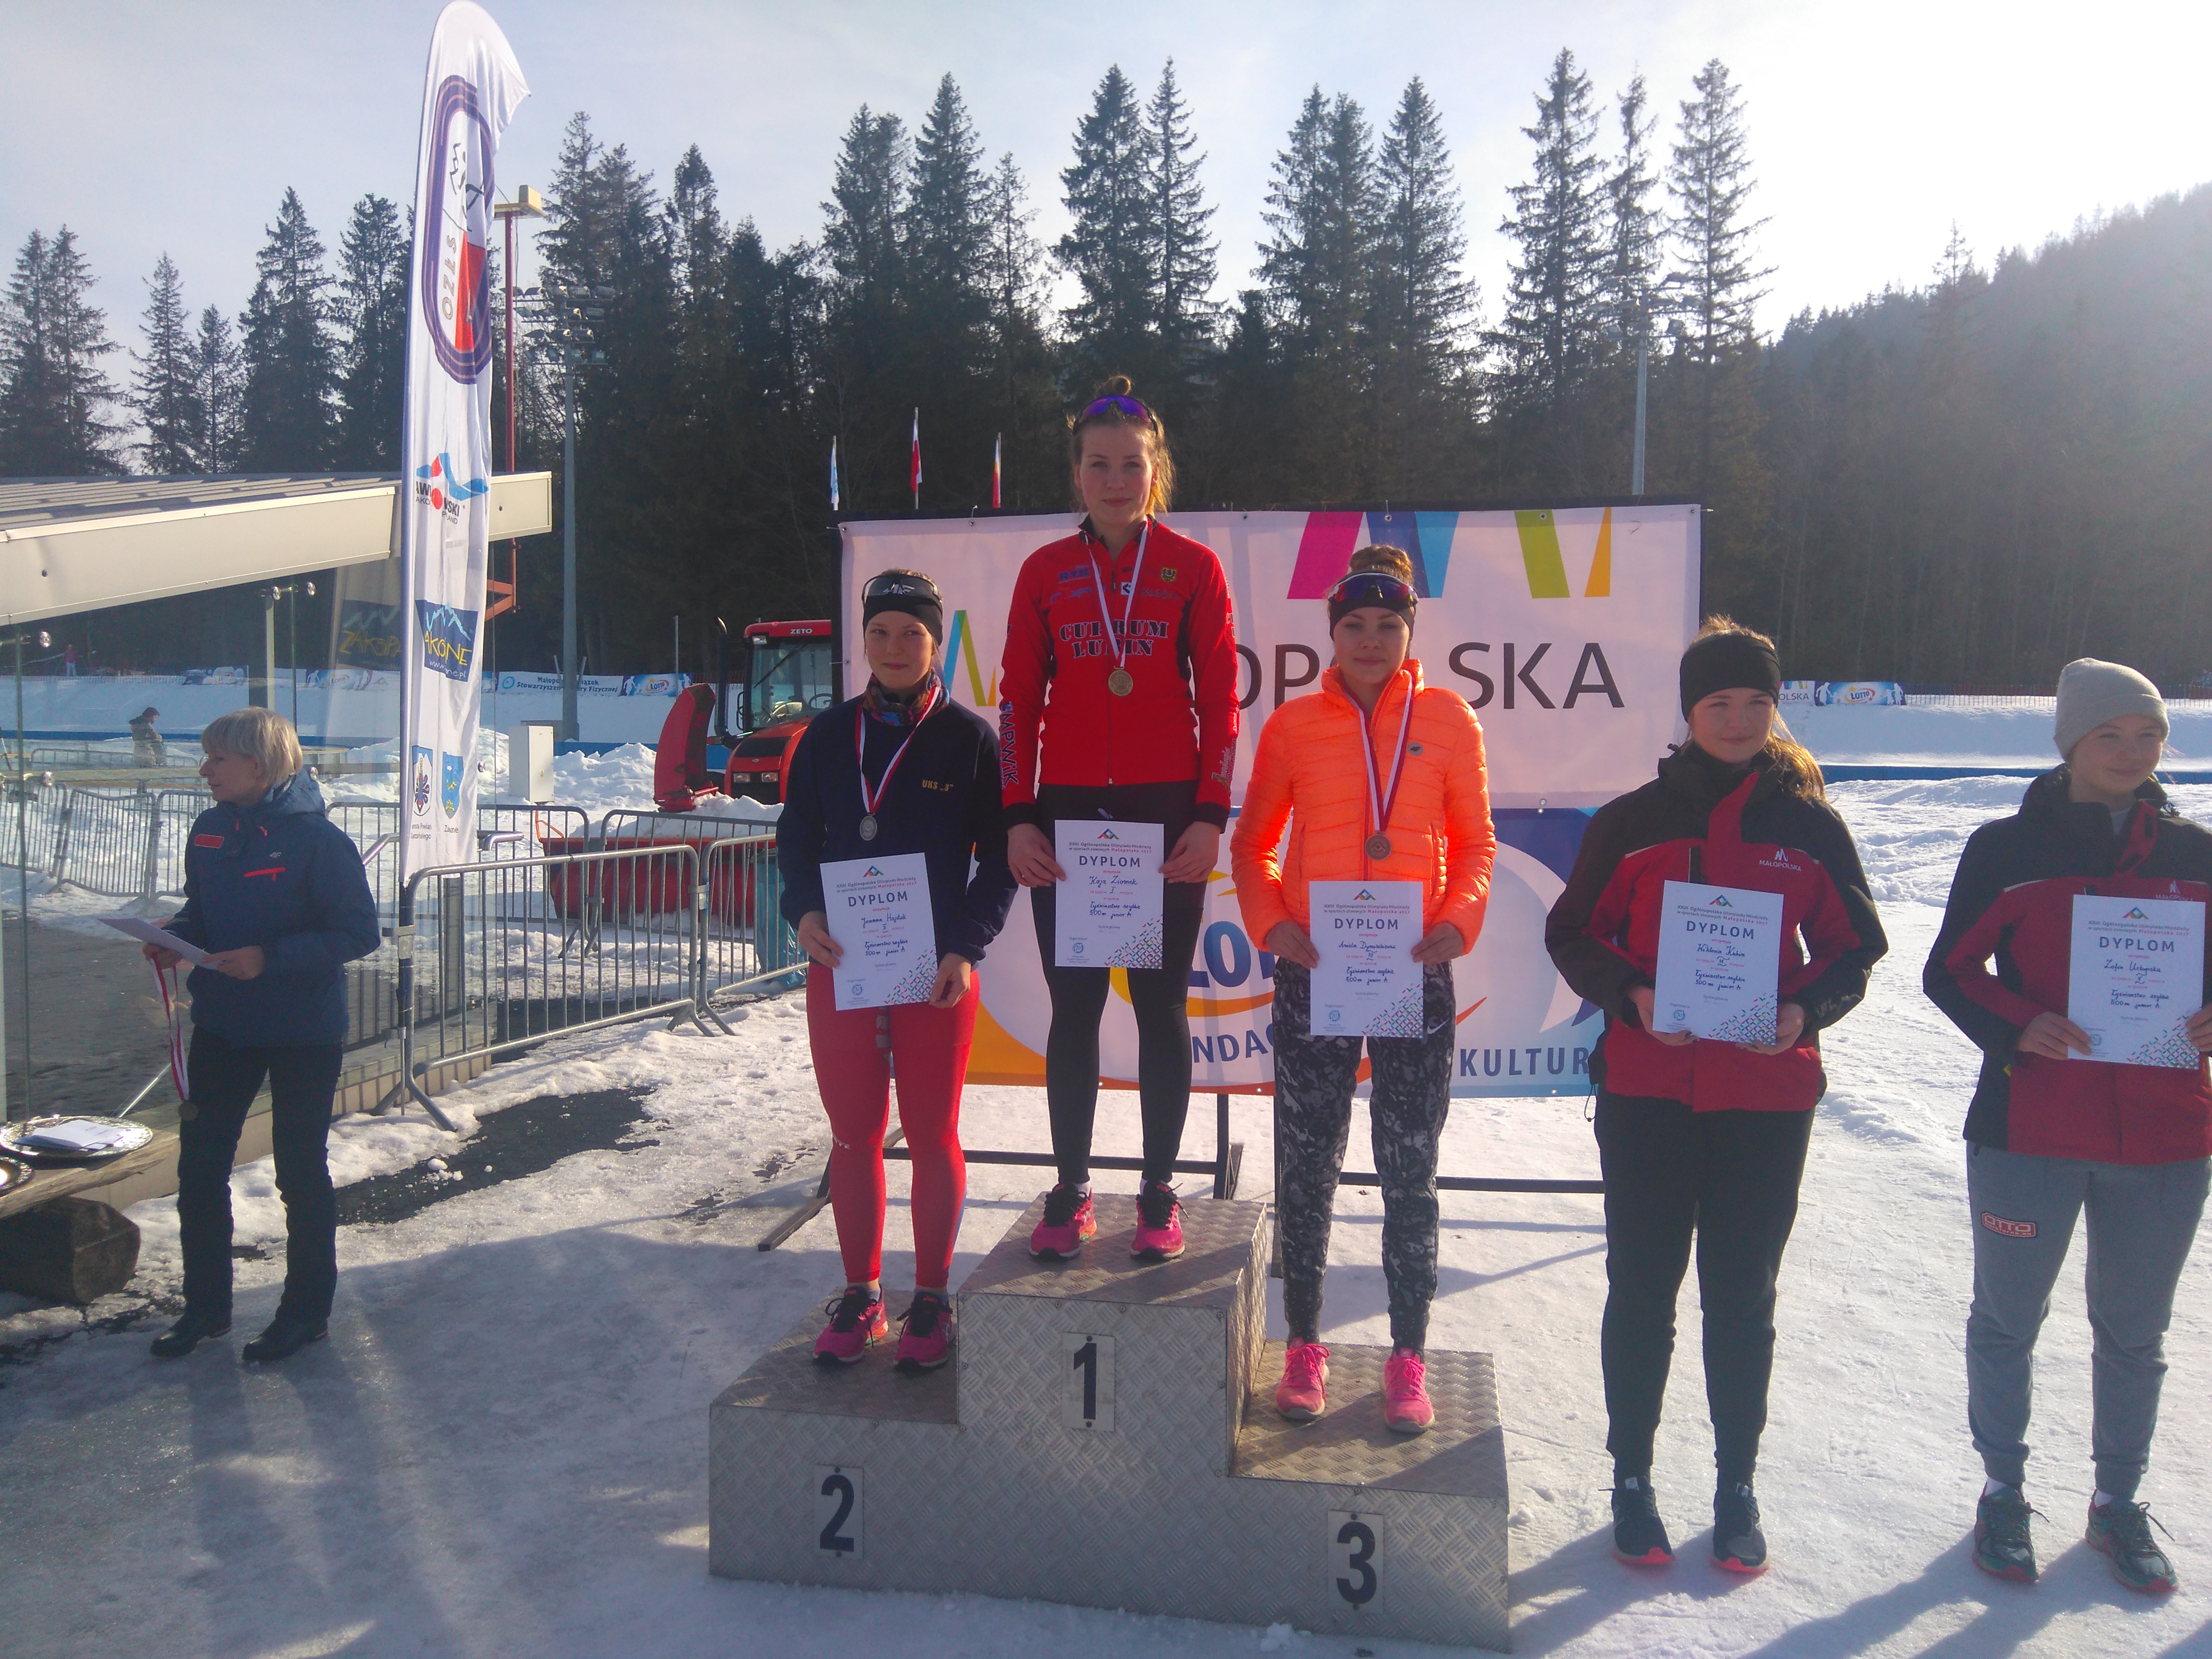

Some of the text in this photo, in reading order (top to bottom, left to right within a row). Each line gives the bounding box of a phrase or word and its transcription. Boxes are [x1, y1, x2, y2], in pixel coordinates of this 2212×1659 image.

[1850, 690, 1870, 700] LOTTO
[922, 780, 938, 789] UKS
[1079, 855, 1140, 867] DYPLOM
[1759, 860, 1801, 872] MAŁOPOLSKA
[848, 891, 907, 906] DYPLOM
[1335, 918, 1398, 929] DYPLOM
[1686, 921, 1754, 938] DYPLOM
[2099, 936, 2174, 952] DYPLOM
[1985, 1215, 2031, 1232] OTTO
[1073, 1343, 1097, 1420] 1
[820, 1475, 854, 1552] 2
[1337, 1522, 1377, 1604] 3
